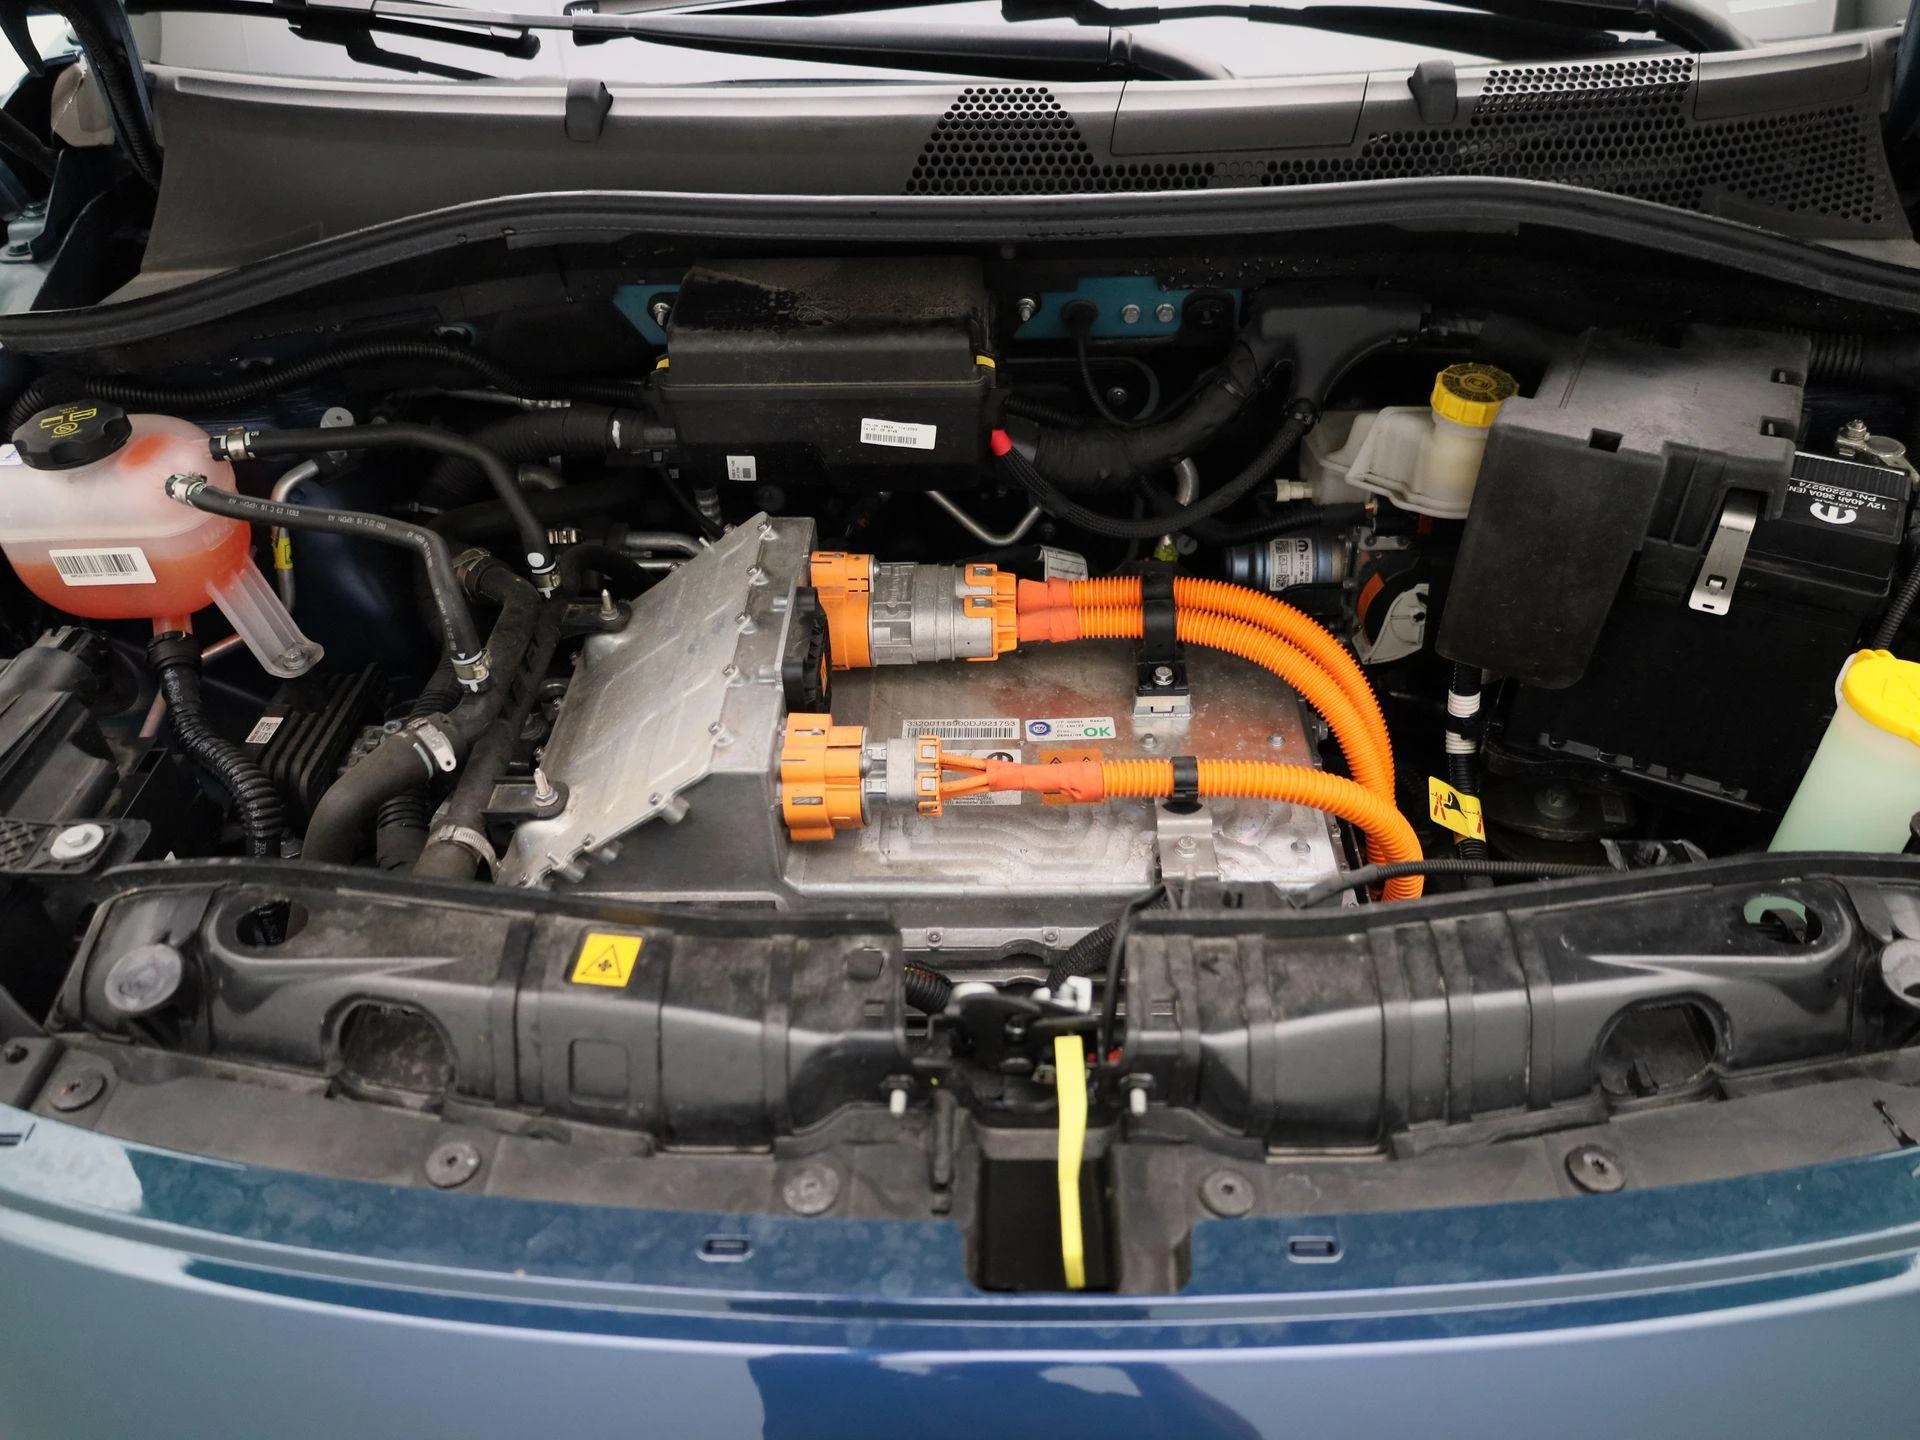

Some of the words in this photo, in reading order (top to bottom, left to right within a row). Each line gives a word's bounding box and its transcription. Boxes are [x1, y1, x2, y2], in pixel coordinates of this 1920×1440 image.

[1809, 489, 1836, 500] 360A
[1838, 496, 1865, 506] 40Ah
[1867, 502, 1887, 510] 12V
[1083, 726, 1111, 737] OK
